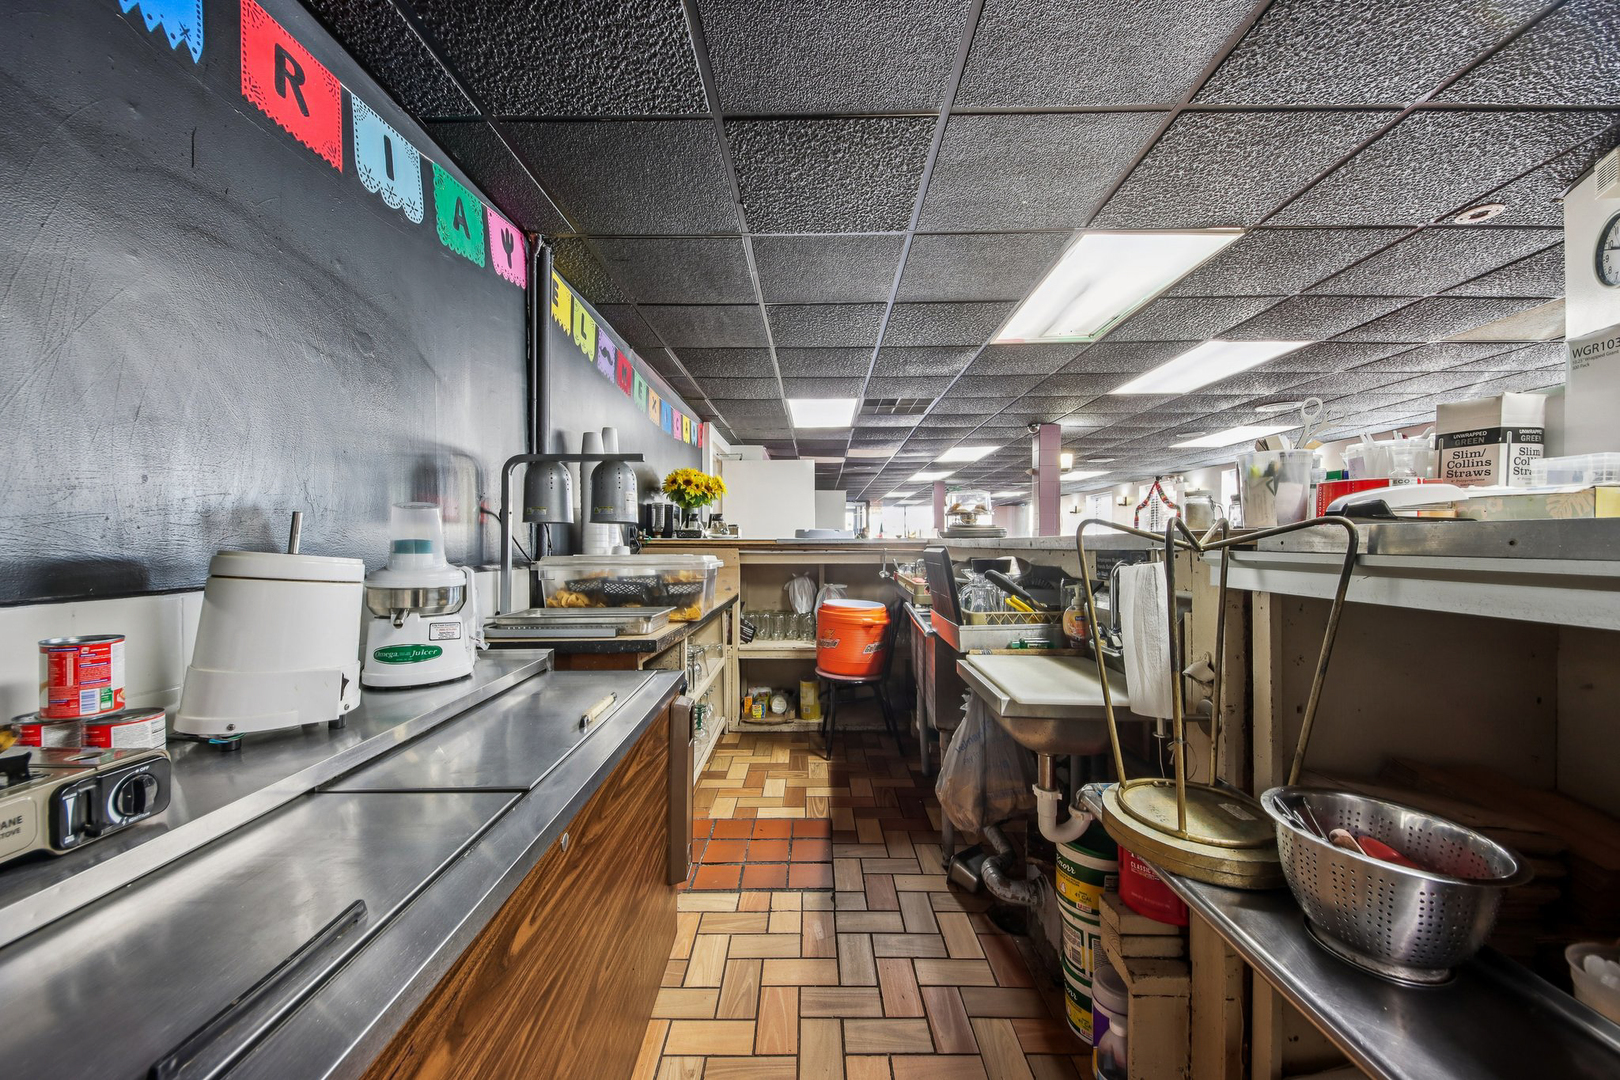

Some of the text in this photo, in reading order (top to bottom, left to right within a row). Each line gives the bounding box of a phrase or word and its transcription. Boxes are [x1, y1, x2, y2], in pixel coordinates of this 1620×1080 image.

[1453, 430, 1488, 440] UNWRAPPED
[1454, 436, 1485, 446] GREEN
[1452, 448, 1487, 460] Slim/
[1446, 459, 1492, 470] Collins
[1446, 469, 1491, 479] Straws
[410, 648, 437, 658] Juicer
[0, 815, 23, 831] ANE
